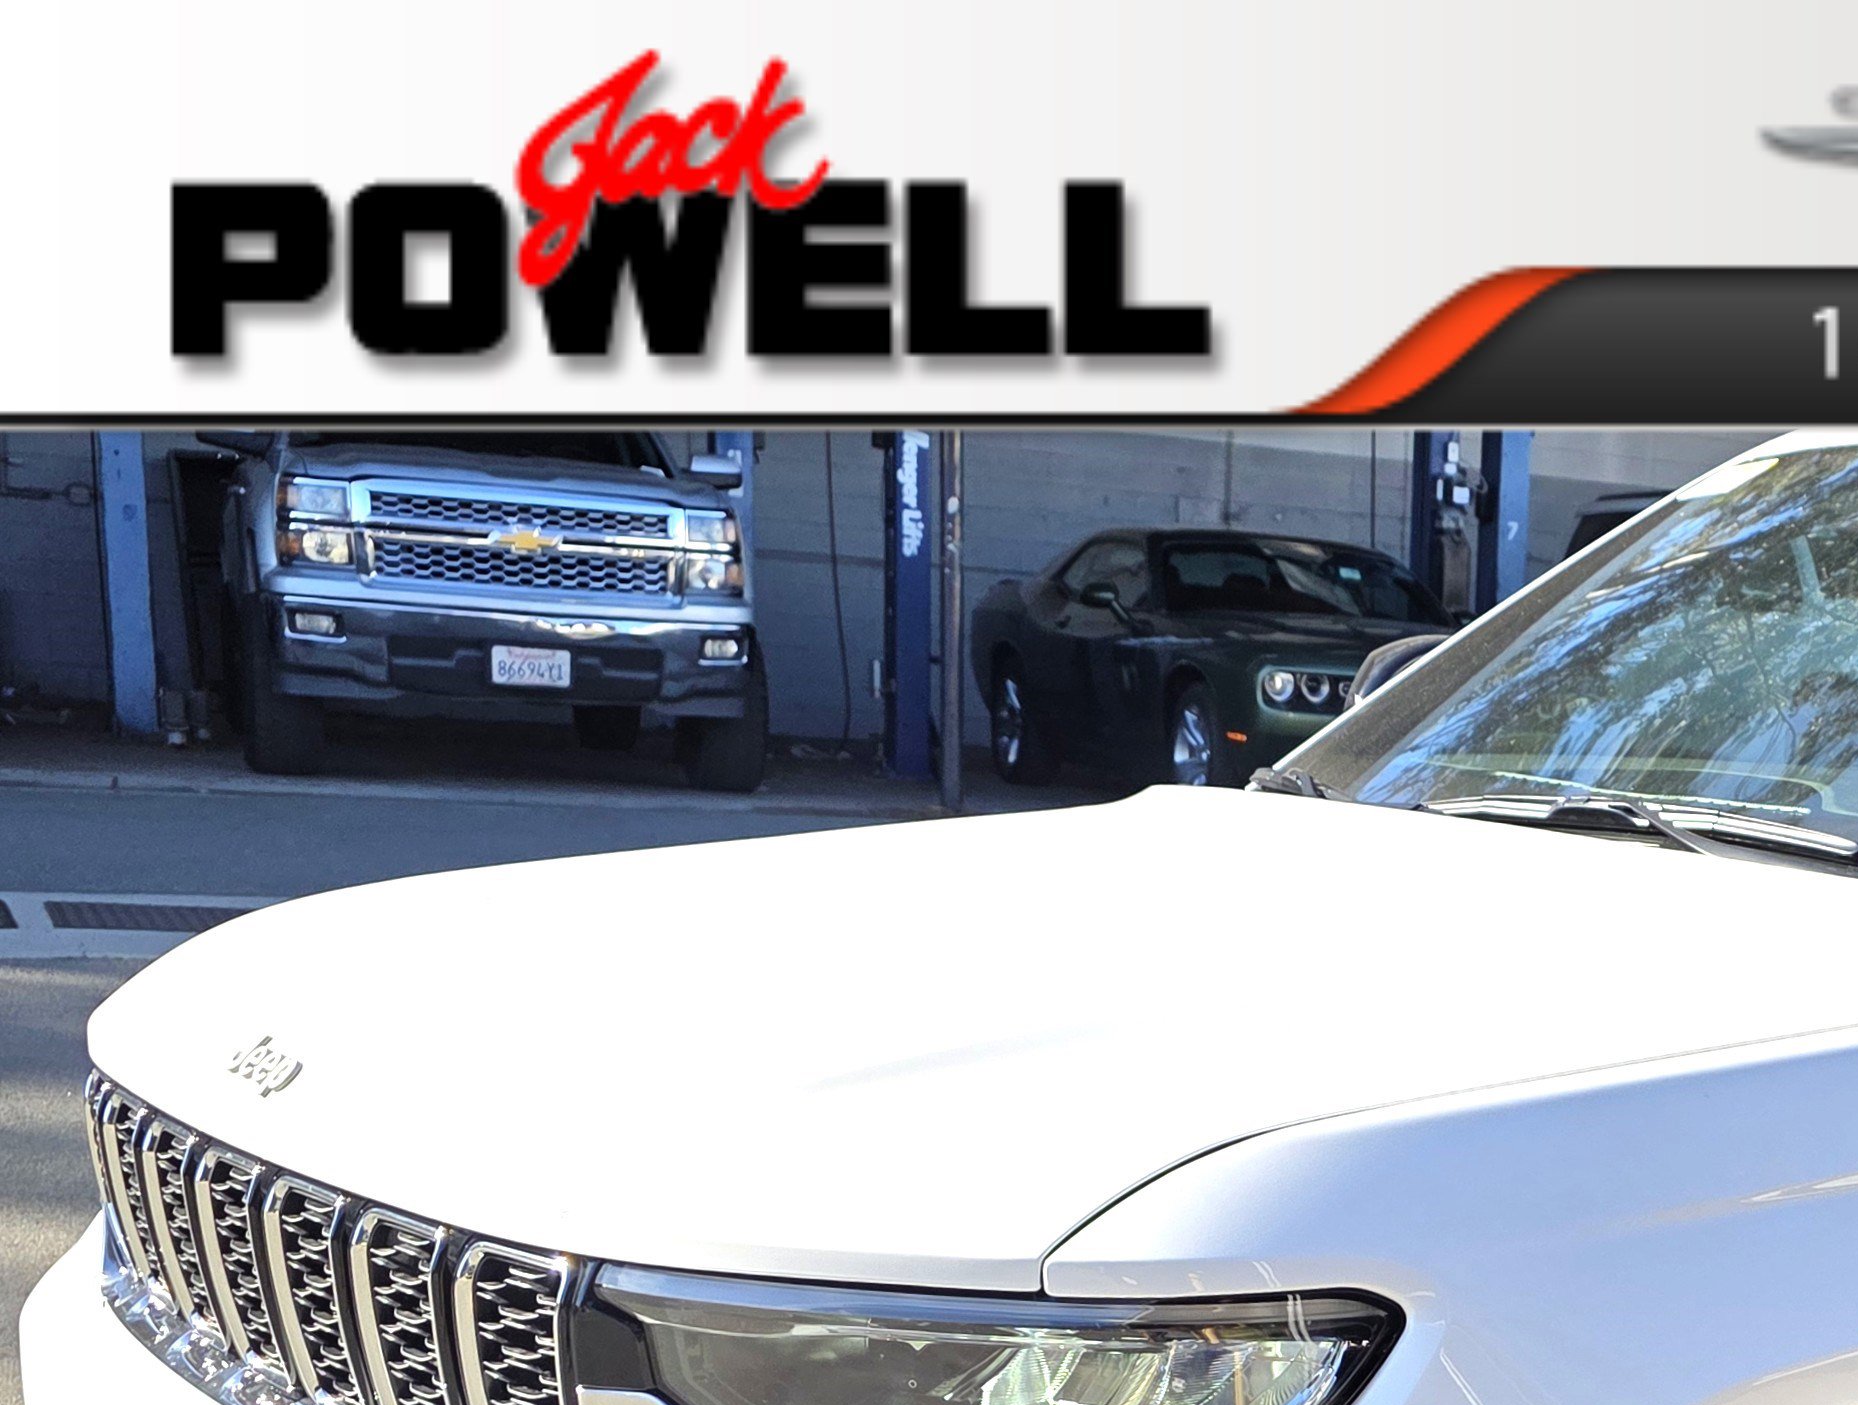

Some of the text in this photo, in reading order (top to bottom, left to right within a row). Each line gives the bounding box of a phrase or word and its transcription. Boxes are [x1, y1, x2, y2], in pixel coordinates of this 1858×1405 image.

[902, 508, 925, 557] Lifts
[1507, 521, 1519, 540] 7
[227, 1035, 303, 1098] Jeep
